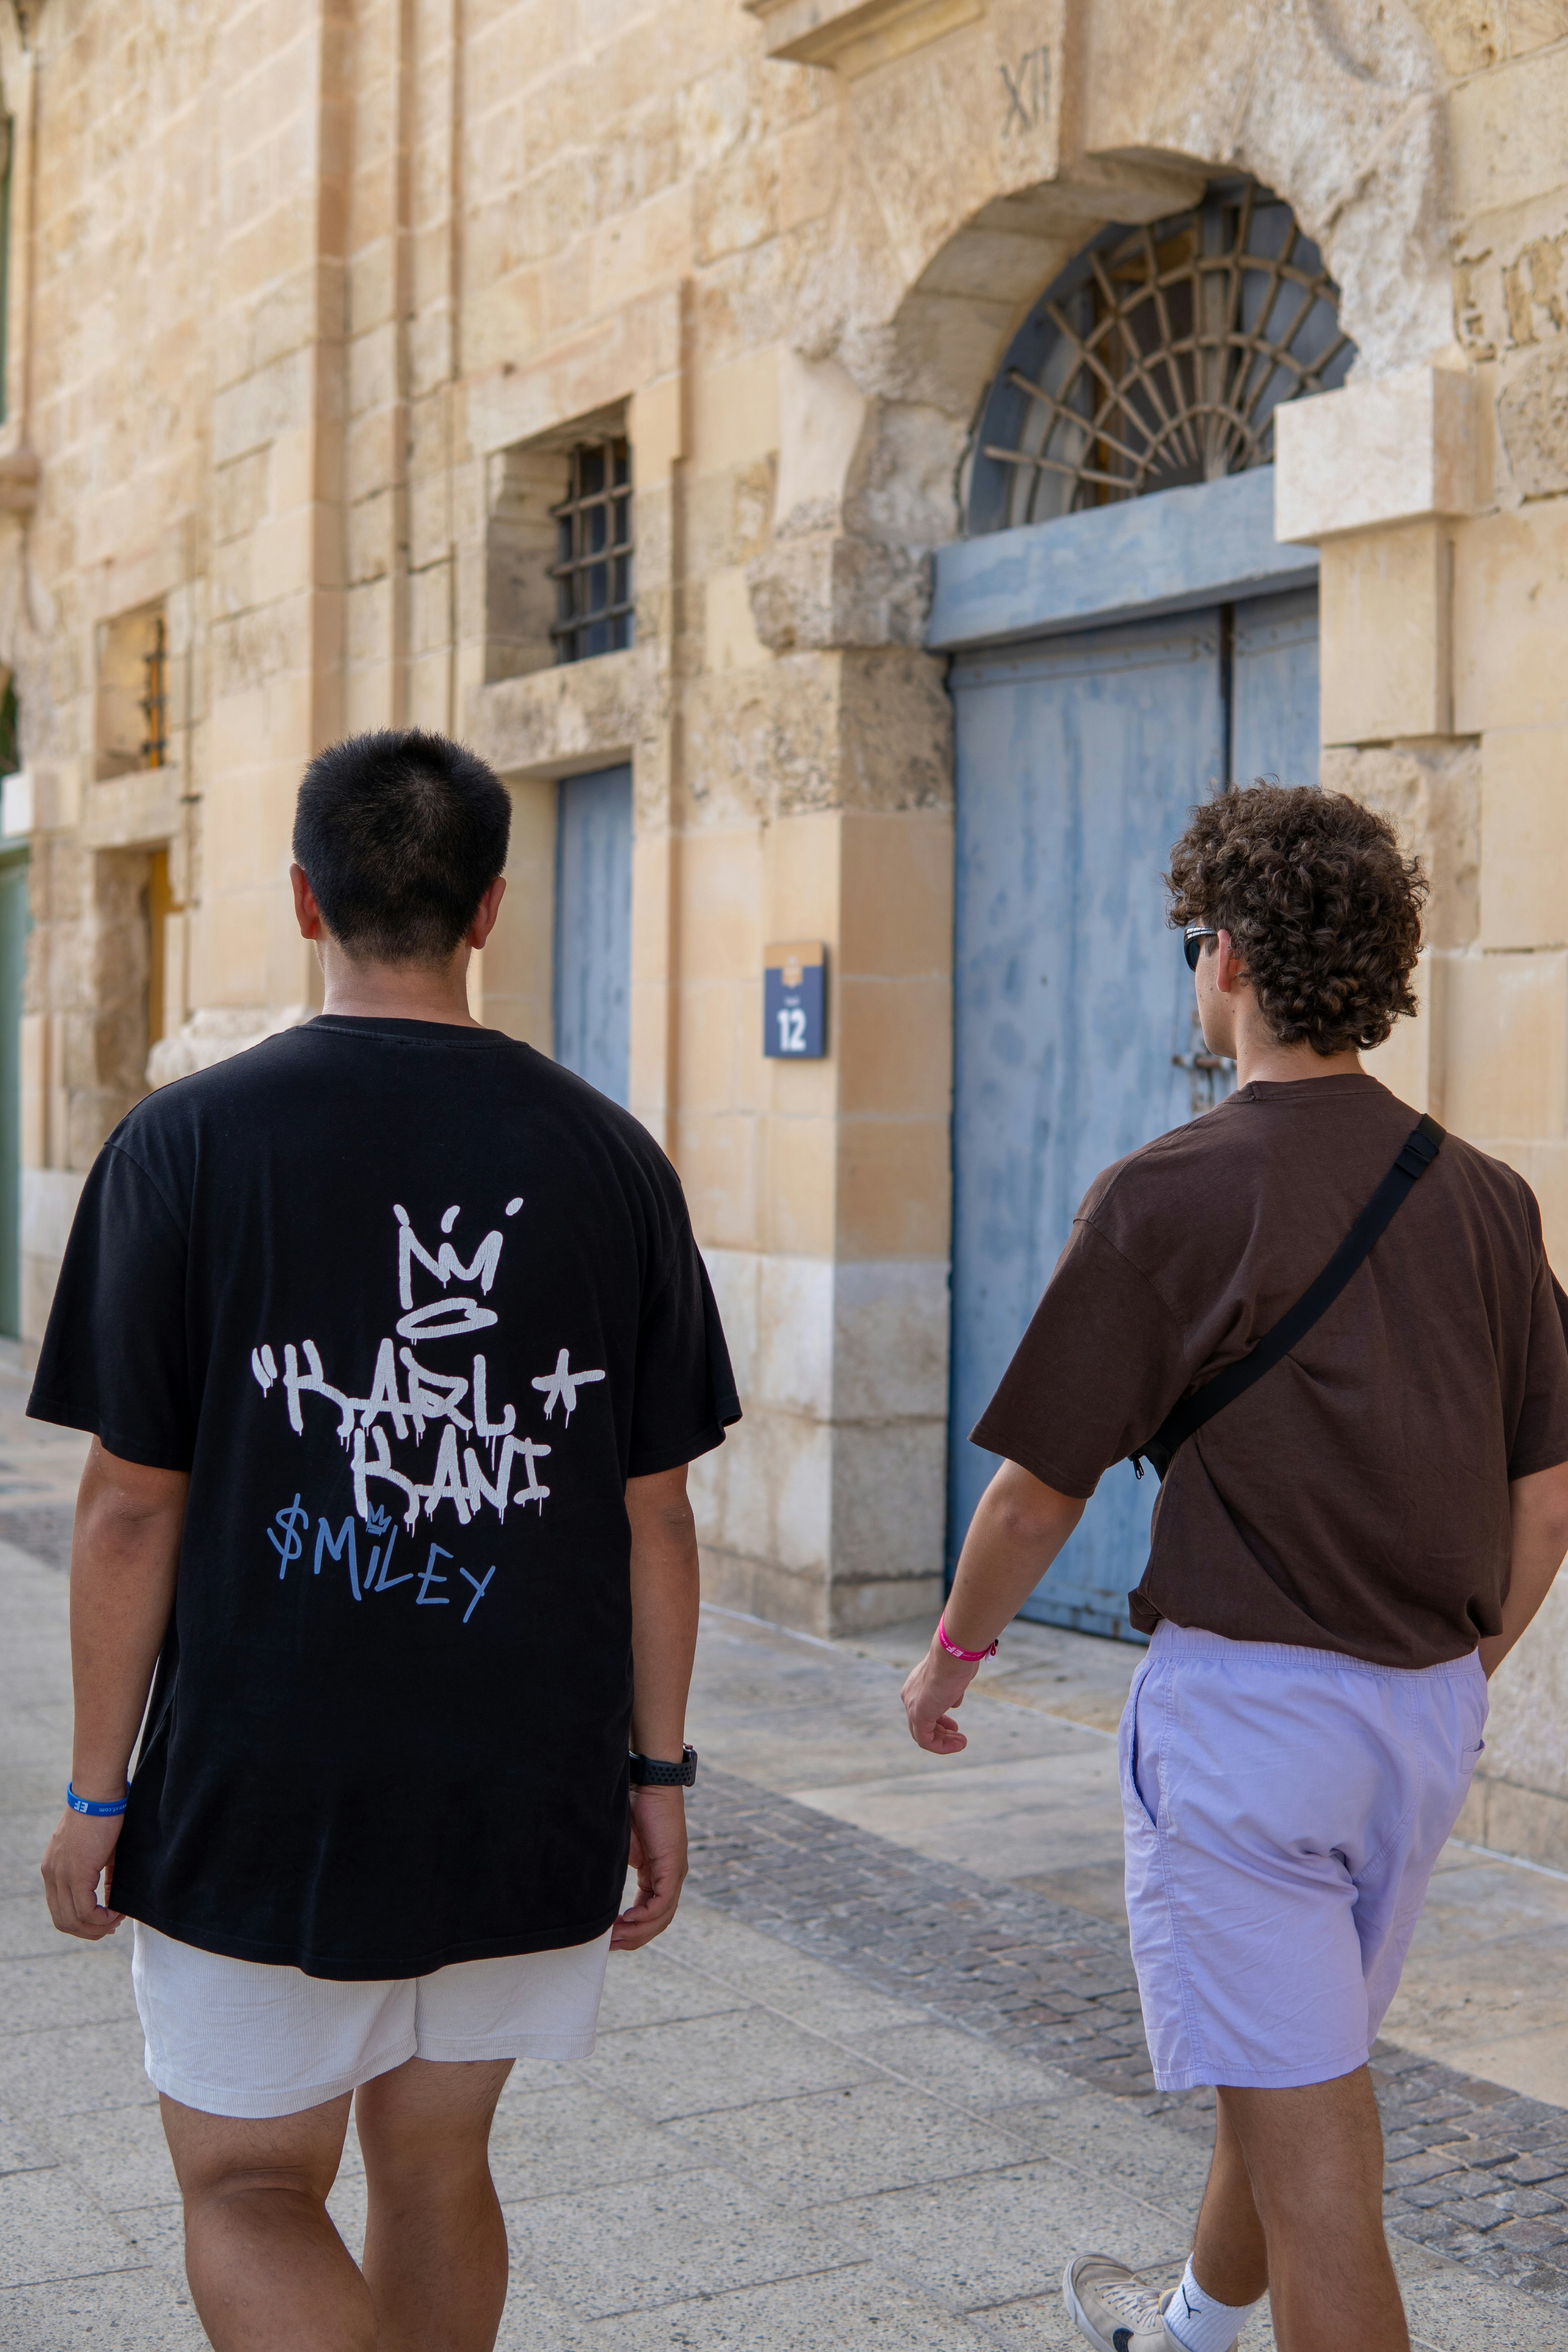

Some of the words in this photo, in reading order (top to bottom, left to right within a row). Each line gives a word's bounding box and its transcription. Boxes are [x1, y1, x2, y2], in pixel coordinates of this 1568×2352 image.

[777, 1007, 807, 1052] 12
[350, 1425, 552, 1537] KANI
[74, 1800, 89, 1813] EF
